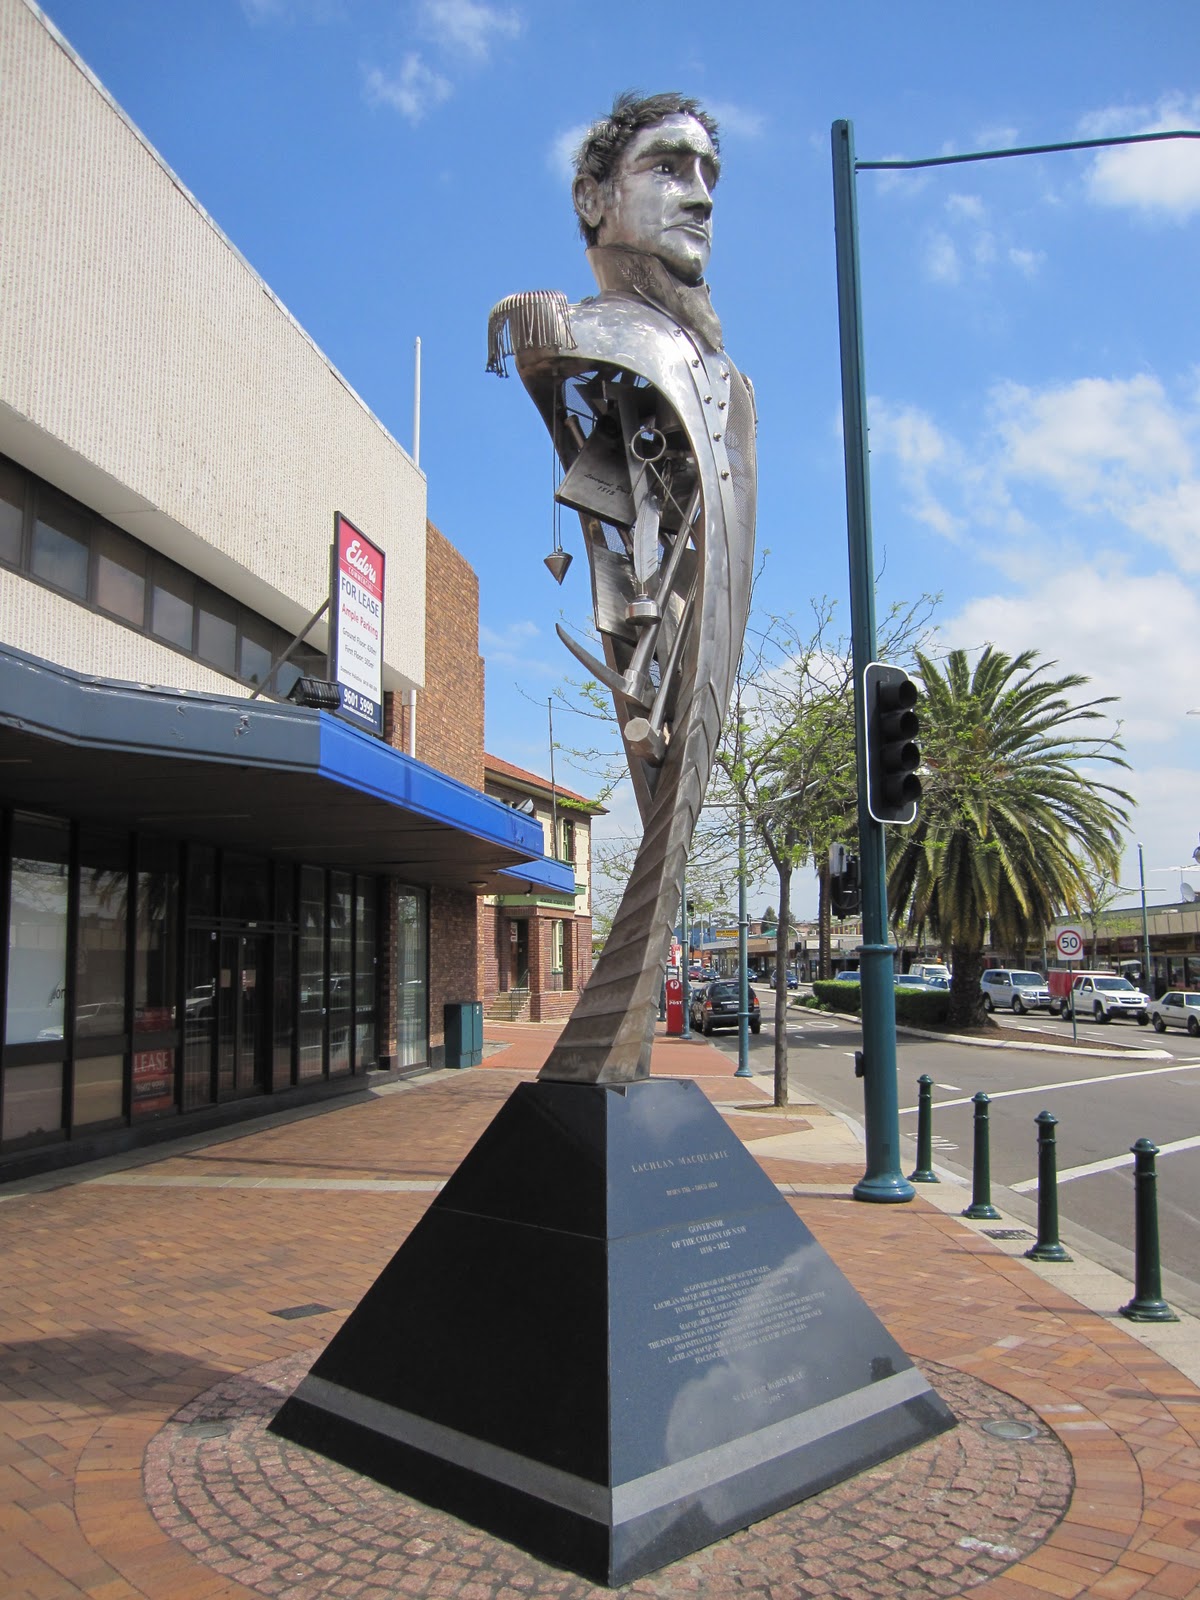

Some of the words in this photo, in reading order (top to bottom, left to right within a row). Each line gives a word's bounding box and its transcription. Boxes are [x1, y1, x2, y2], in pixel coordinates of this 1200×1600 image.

[346, 540, 376, 584] Elders
[342, 577, 356, 600] FOR
[358, 590, 380, 618] LEASE
[342, 603, 359, 624] Ample
[360, 616, 378, 640] Parking
[342, 627, 356, 642] Ground
[344, 644, 353, 656] First
[344, 688, 358, 708] 9601
[360, 698, 374, 716] 5999
[1062, 936, 1078, 948] 50
[134, 1052, 169, 1072] LEASE
[631, 1159, 675, 1173] LACHLAN
[678, 1150, 730, 1165] MACQUARIE
[688, 1220, 725, 1234] GOVERNOR
[671, 1240, 680, 1249] OF
[681, 1236, 695, 1247] THE
[696, 1230, 723, 1244] COLONY
[722, 1229, 731, 1237] OF
[717, 1241, 731, 1250] 1822
[654, 1298, 680, 1310] LACHLAN
[679, 1290, 710, 1303] MACQUARIE
[681, 1304, 693, 1312] THE
[648, 1341, 660, 1350] THE
[660, 1331, 697, 1346] INTEGRATION
[674, 1343, 685, 1352] AND
[668, 1350, 694, 1364] LACHLAN
